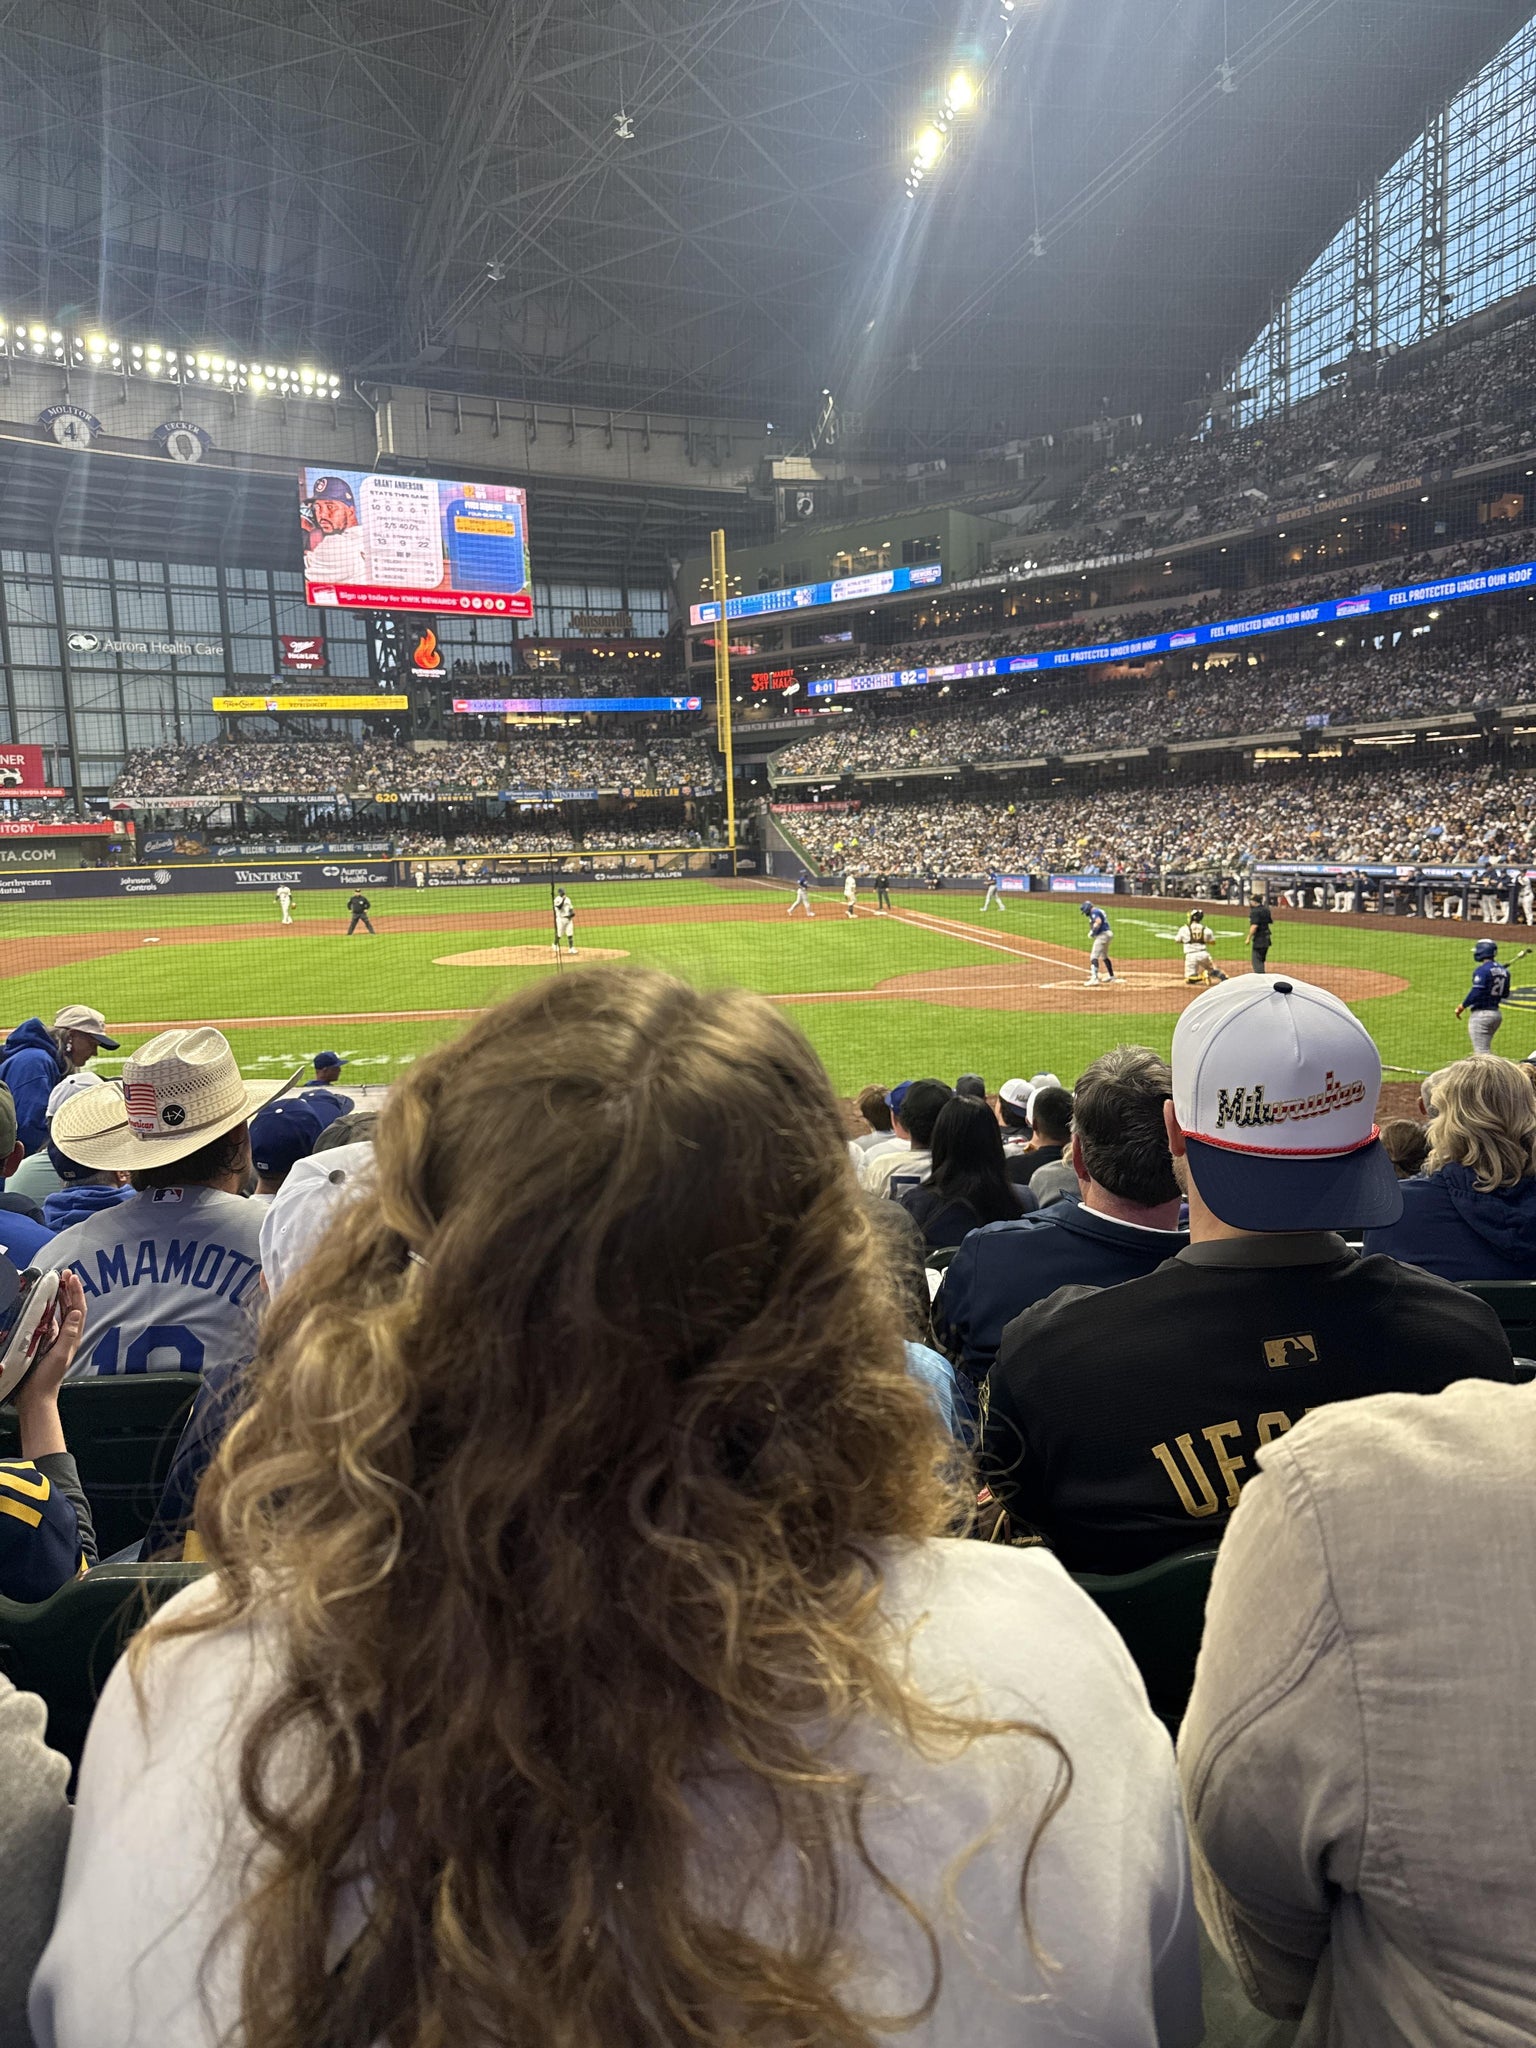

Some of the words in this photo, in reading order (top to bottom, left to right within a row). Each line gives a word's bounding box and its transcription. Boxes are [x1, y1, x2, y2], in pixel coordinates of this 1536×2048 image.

[47, 405, 93, 422] MOLITOR
[64, 422, 77, 441] 4
[164, 422, 200, 433] UECKER
[374, 479, 393, 489] GRANT
[394, 480, 424, 491] ANDERSON
[1276, 505, 1311, 523] BREWERS
[1314, 492, 1363, 514] COMMUNITY
[1366, 476, 1422, 501] FOUNDATION
[1388, 593, 1408, 605] FEEL
[1408, 583, 1456, 601] PROTECTED
[1457, 577, 1486, 593] UNDER
[1487, 573, 1506, 587] OUR
[1508, 568, 1533, 584] ROOF
[568, 611, 633, 629] Johnsonville
[1210, 628, 1225, 638] FEEL
[1226, 619, 1262, 635] PROTECTED
[1262, 615, 1285, 629] UNDER
[1286, 611, 1300, 624] OUR
[1300, 608, 1320, 622] ROOF
[103, 639, 148, 653] Aurora
[150, 640, 192, 655] Health
[195, 642, 224, 656] Care
[1054, 654, 1070, 664] FEEL
[1070, 648, 1109, 662] PROTECTED
[1110, 644, 1130, 657] UNDER
[1130, 642, 1141, 654] OUR
[1142, 639, 1157, 651] ROOF
[900, 670, 917, 685] 92
[375, 793, 399, 802] 620
[399, 793, 436, 802] WTMJ
[551, 790, 595, 799] WINTRUST
[634, 788, 662, 797] NICOLET
[664, 787, 680, 797] LAW
[240, 846, 268, 854] WELCOME
[276, 845, 303, 854] DELICIOUS
[329, 844, 355, 852] WELCOME
[363, 843, 390, 851] DELICIOUS
[0, 849, 57, 861] TA.COM
[235, 870, 303, 882] WINTRUST
[341, 867, 368, 876] Aurora
[120, 877, 151, 885] Johnson
[341, 875, 368, 884] Health
[368, 874, 388, 883] Care
[491, 877, 520, 885] BULLPEN
[126, 883, 157, 892] Controls
[1491, 977, 1506, 996] 21
[1215, 1070, 1366, 1130] Milwaukee
[66, 1238, 263, 1306] AMAMOTO
